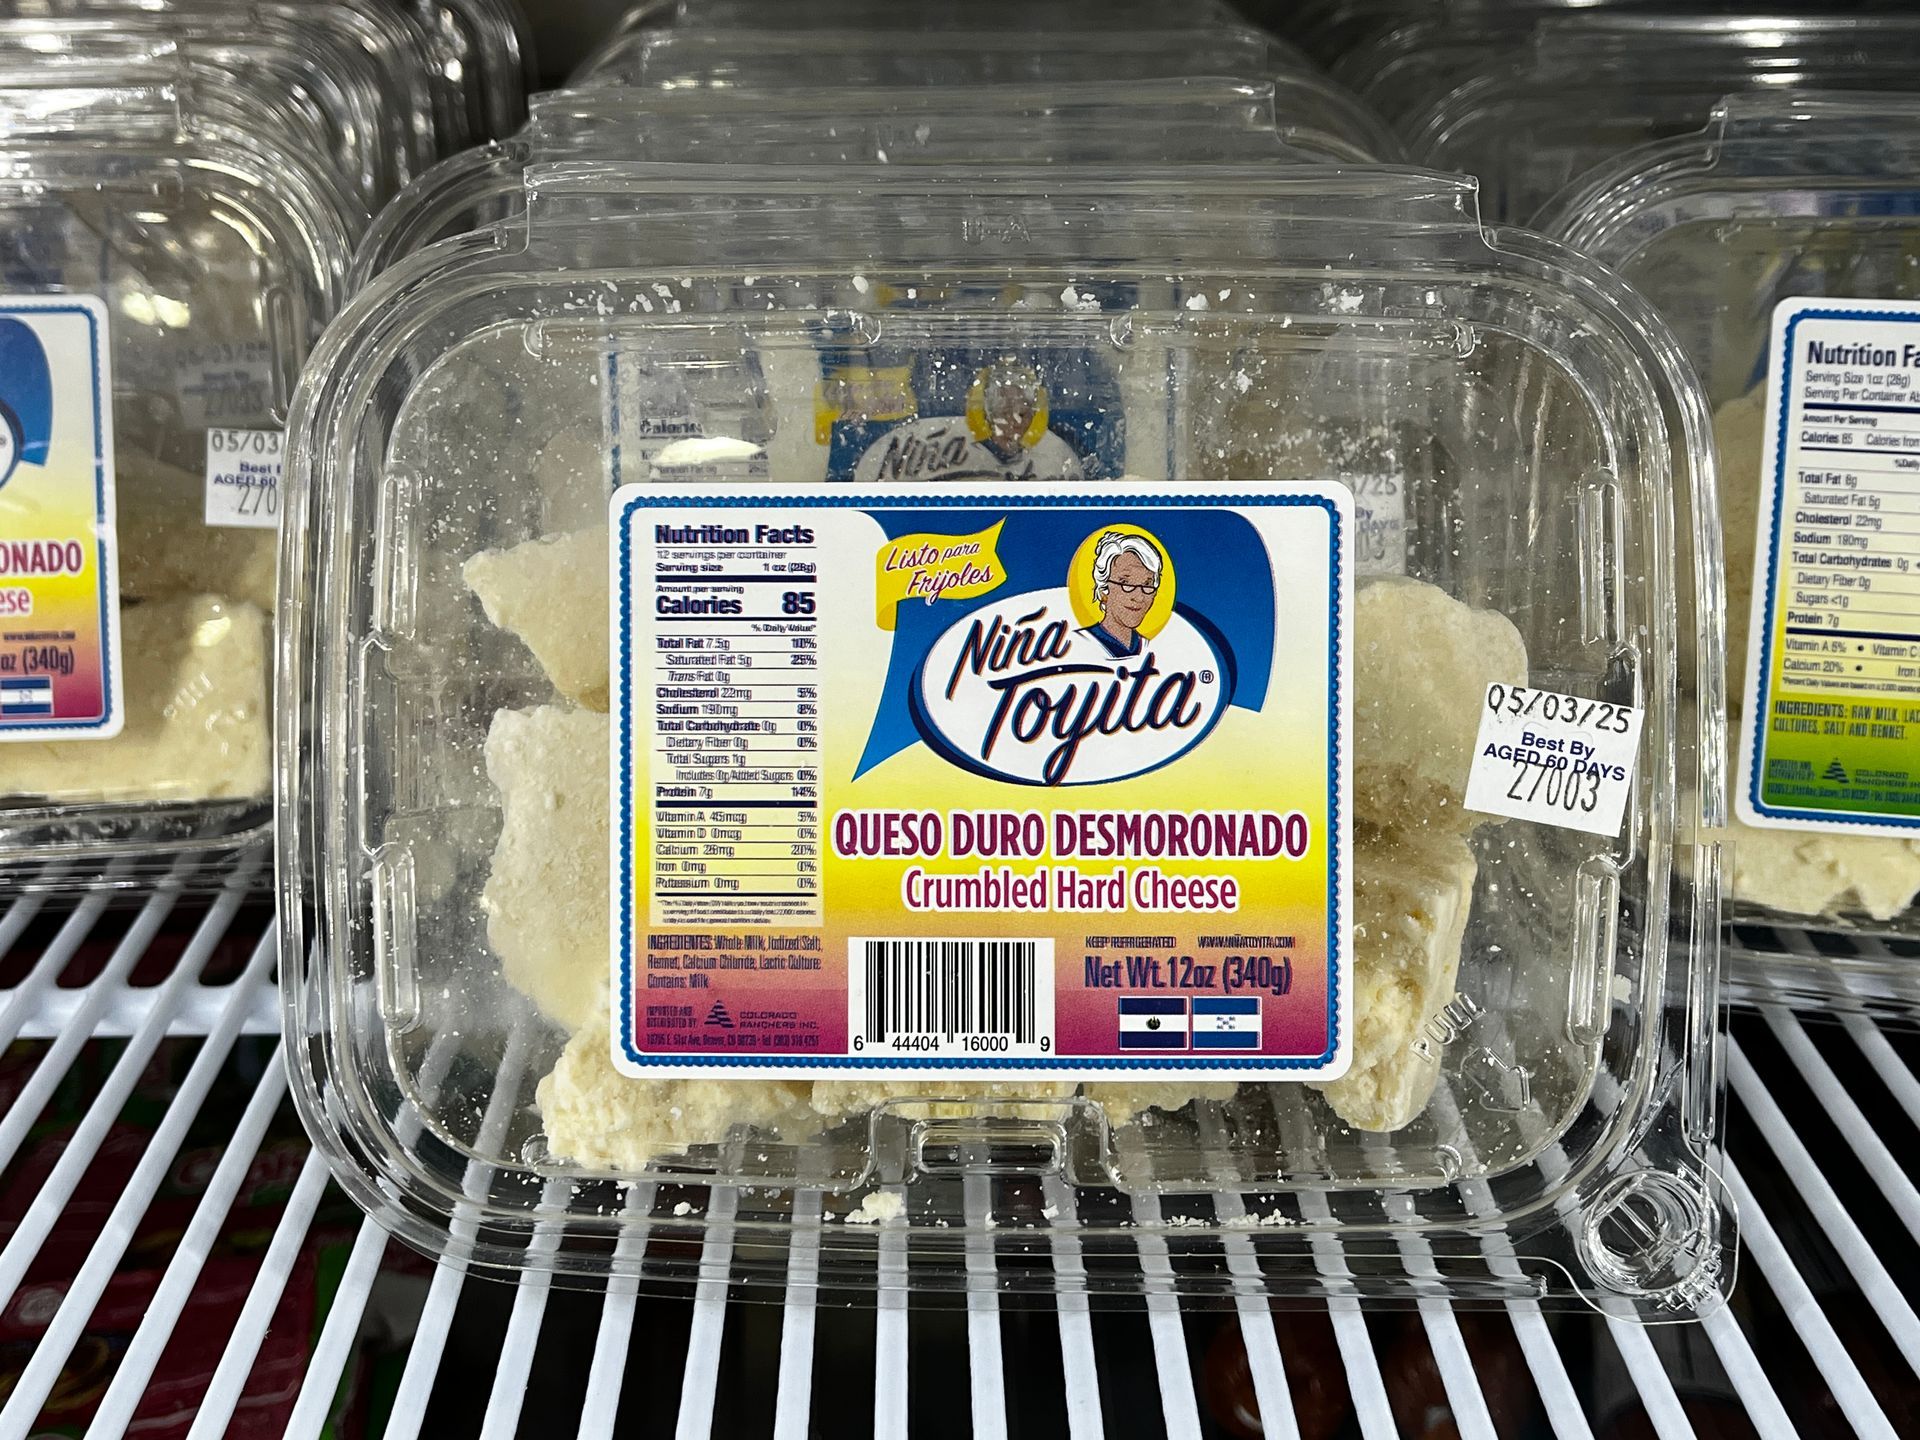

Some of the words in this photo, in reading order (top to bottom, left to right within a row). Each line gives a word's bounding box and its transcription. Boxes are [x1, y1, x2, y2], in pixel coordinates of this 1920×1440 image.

[1807, 340, 1897, 367] Nutrition
[1805, 370, 1841, 386] Serving
[1844, 371, 1864, 384] Size
[1804, 386, 1840, 401] Serving
[1843, 387, 1860, 400] Per
[1861, 388, 1907, 402] Container
[1803, 413, 1833, 424] Amount
[1834, 414, 1848, 425] Per
[1848, 415, 1878, 427] Serving
[1801, 430, 1839, 444] Calories
[1866, 433, 1901, 447] Calories
[239, 462, 272, 474] Best
[214, 474, 256, 487] AGED
[1799, 471, 1823, 484] Total
[1825, 472, 1842, 485] Fat
[1804, 491, 1849, 506] Saturated
[1851, 493, 1867, 507] Fat
[1795, 511, 1852, 526] Cholesterol
[1855, 514, 1882, 529] 22mg
[655, 524, 750, 544] Nutrition
[755, 524, 815, 544] Facts
[1794, 531, 1832, 545] Sodium
[672, 550, 716, 562] servings
[717, 552, 736, 562] per
[737, 550, 788, 560] container
[884, 543, 940, 573] Listo
[941, 541, 981, 559] para
[1792, 551, 1817, 564] Total
[1819, 552, 1893, 570] Carbohydrates
[655, 563, 699, 573] Serving
[700, 563, 724, 572] size
[906, 563, 994, 604] Frijoles
[1797, 571, 1830, 588] Dietary
[1832, 573, 1856, 587] Fiber
[655, 585, 692, 593] Amount
[693, 586, 709, 594] per
[710, 585, 745, 595] serving
[655, 595, 743, 615] Calories
[782, 591, 816, 615] 85
[1795, 590, 1829, 606] Sugars
[1787, 611, 1823, 625] Protein
[1828, 614, 1840, 628] 7g
[763, 624, 786, 634] Daily
[656, 638, 684, 649] Total
[685, 638, 704, 649] Fat
[706, 638, 730, 651] 7.5g
[791, 638, 817, 649] 10%
[1785, 638, 1821, 653] Vitamin
[1822, 640, 1829, 652] A
[1873, 643, 1907, 657] Vitamin
[23, 645, 75, 675] (340g)
[666, 654, 717, 665] Saturated
[718, 654, 736, 665] Fat
[790, 654, 817, 665] 25%
[945, 606, 1071, 701] Niña
[1783, 657, 1821, 672] Calcium
[1897, 664, 1917, 678] Iron
[668, 671, 695, 682] Trans
[696, 671, 715, 682] Fat
[656, 687, 719, 698] Cholesterol
[720, 688, 752, 700] 22mg
[797, 687, 817, 698] 5%
[656, 704, 699, 715] Sodium
[1487, 684, 1632, 734] 05/03/25
[1775, 700, 1848, 719] INGREDIENTS:
[1852, 705, 1872, 720] RAW
[656, 720, 684, 731] Total
[685, 720, 761, 733] Carbohydrate
[797, 720, 817, 731] 0%
[1824, 720, 1845, 736] SALT
[1849, 722, 1868, 737] AND
[666, 737, 704, 750] Dietary
[705, 737, 732, 748] Fiber
[797, 737, 817, 748] 0%
[1521, 731, 1565, 753] Best
[1569, 740, 1596, 761] By
[666, 753, 691, 764] Total
[692, 753, 730, 766] Sugars
[1483, 743, 1541, 766] AGED
[1545, 754, 1569, 771] 60
[1573, 759, 1626, 781] DAYS
[676, 770, 715, 781] Includes
[729, 770, 760, 781] Added
[760, 770, 794, 783] Sugars
[797, 770, 817, 781] 0%
[656, 786, 697, 797] Protein
[1506, 758, 1600, 812] 27003
[656, 811, 695, 822] Vitamin
[696, 811, 705, 822] A
[656, 828, 695, 839] Vitamin
[697, 828, 707, 839] D
[797, 828, 817, 839] 0%
[835, 813, 942, 858] QUESO
[953, 813, 1045, 857] DURO
[1055, 813, 1308, 858] DESMORONADO
[656, 844, 699, 855] Calcium
[790, 844, 817, 855] 20%
[656, 861, 677, 872] Iron
[797, 861, 817, 872] 0%
[656, 877, 710, 889] Potassium
[797, 877, 817, 889] 0%
[906, 869, 1046, 909] Crumbled
[1057, 869, 1125, 909] Hard
[1135, 870, 1237, 909] Cheese
[714, 935, 743, 950] Whole
[1085, 936, 1110, 948] KEEP
[1111, 936, 1177, 948] REFRIGERATED
[682, 954, 717, 969] Calcium
[759, 954, 786, 969] Lactic
[648, 973, 687, 988] Contains:
[689, 974, 709, 988] Milk
[1084, 955, 1122, 988] Net
[1222, 955, 1293, 995] (340g)
[740, 1012, 797, 1020] COLORADO
[740, 1021, 796, 1029] RANCHERS
[854, 1035, 864, 1051] 6
[892, 1035, 940, 1052] 44404
[962, 1036, 1008, 1052] 16000
[1040, 1036, 1051, 1052] 9
